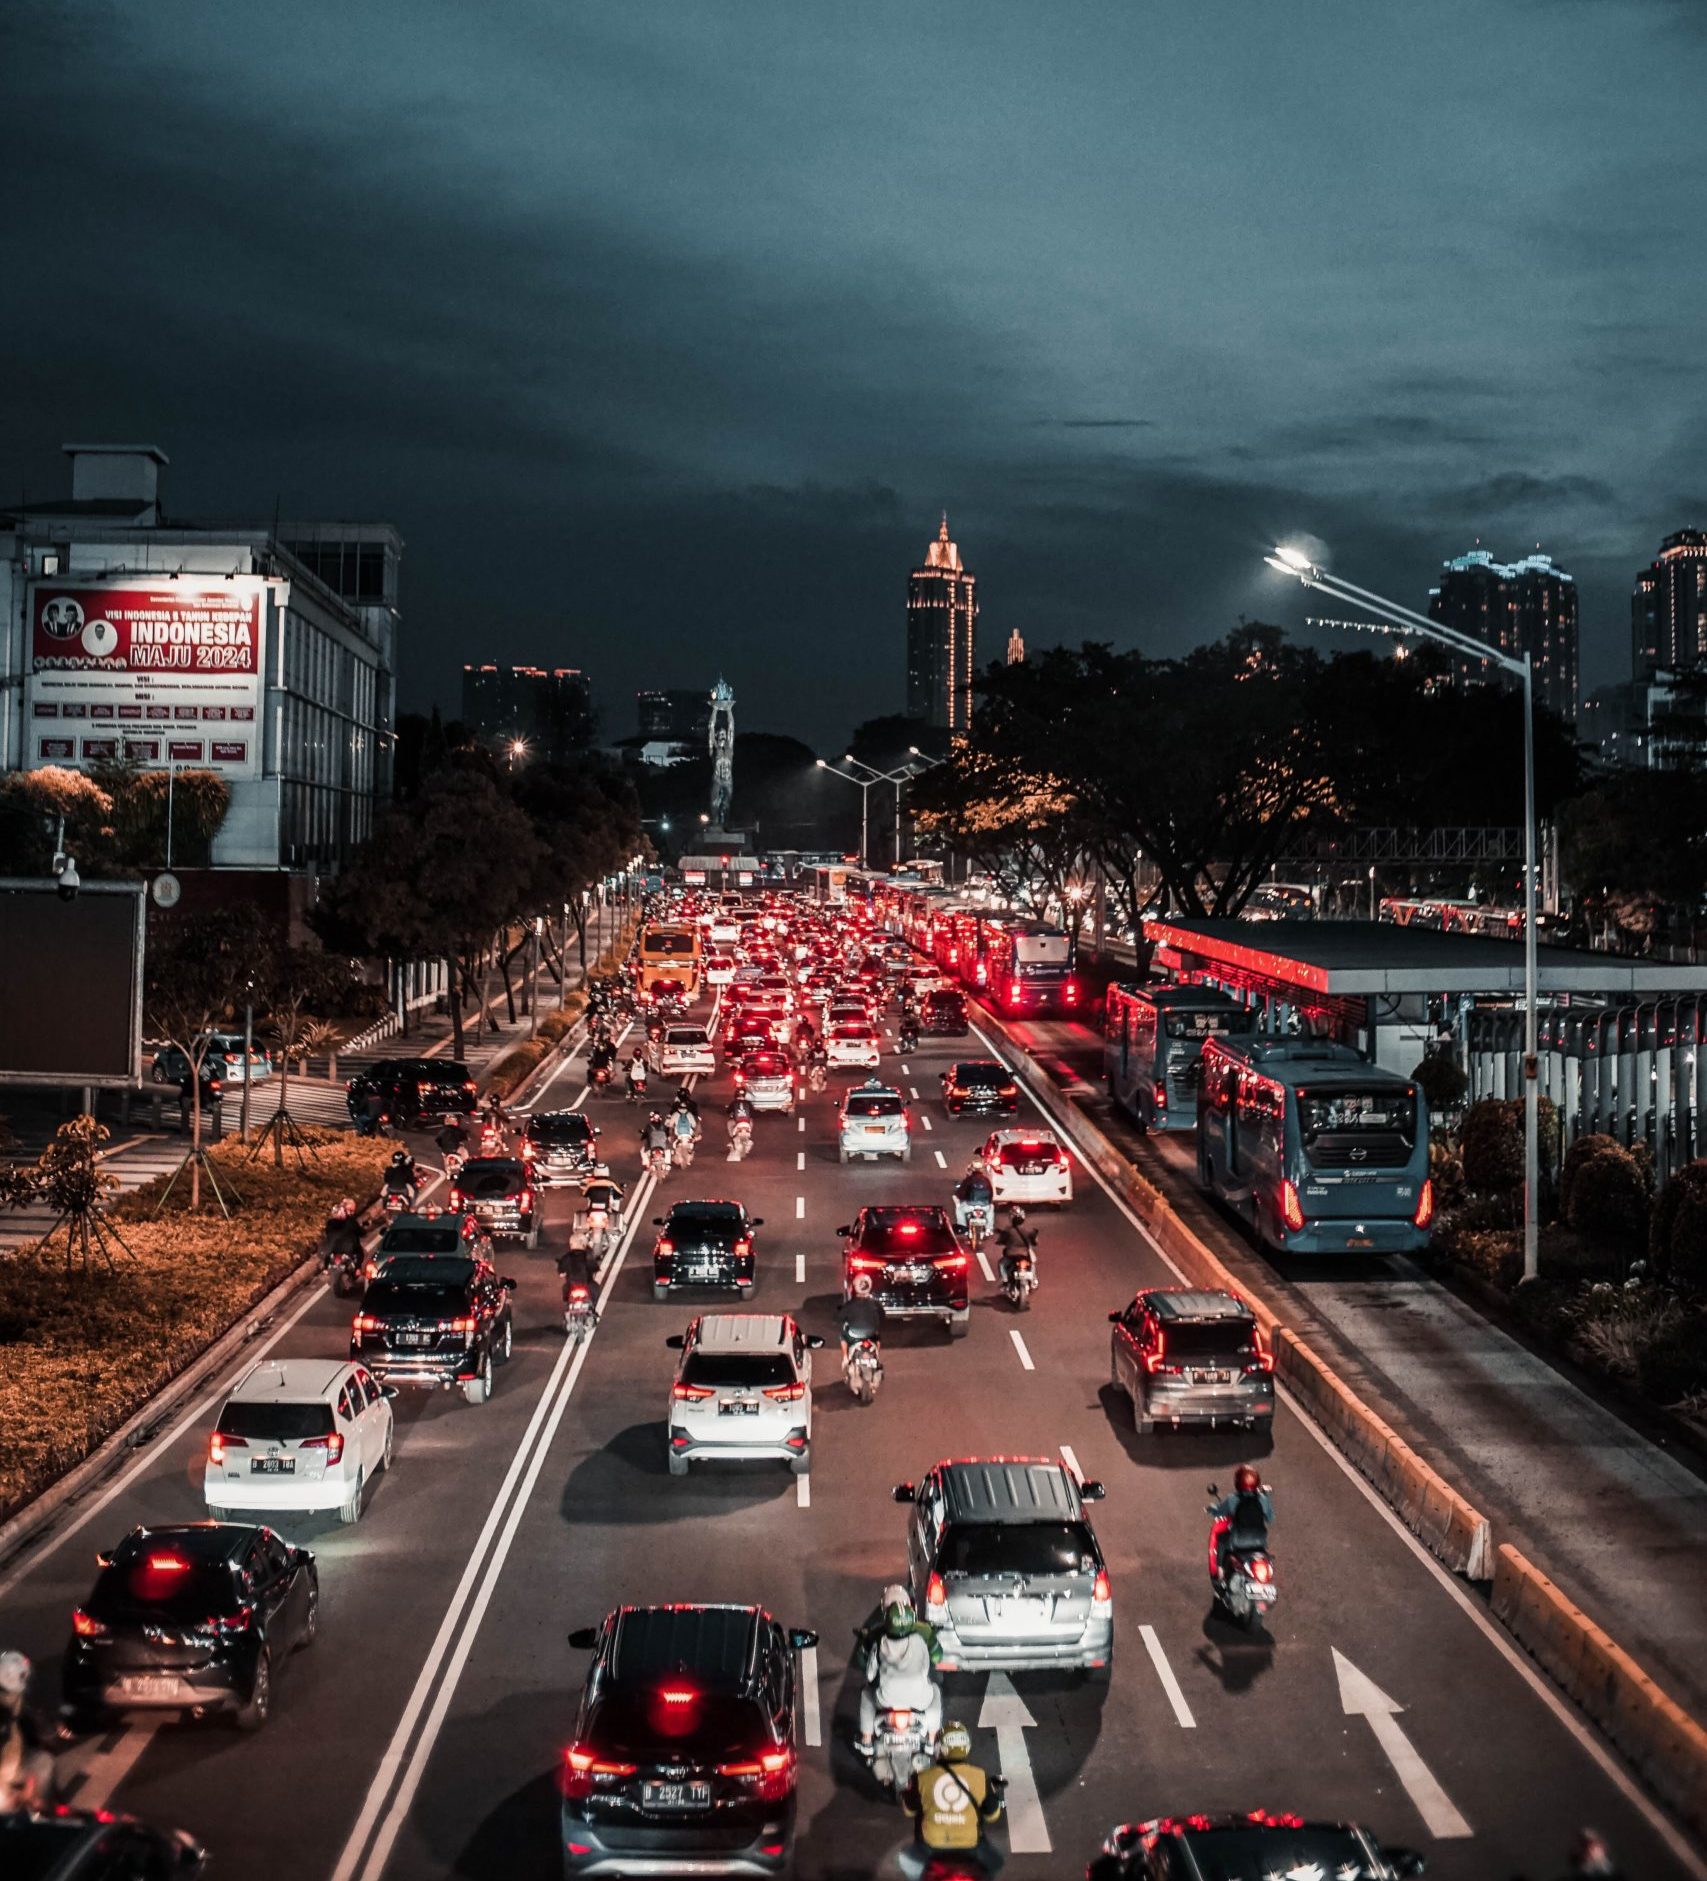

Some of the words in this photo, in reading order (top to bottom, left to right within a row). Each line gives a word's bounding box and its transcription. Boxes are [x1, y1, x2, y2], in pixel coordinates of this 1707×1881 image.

[124, 610, 170, 621] INDONESIA
[130, 621, 252, 645] INDONESIA
[130, 645, 191, 668] MAJU
[196, 646, 251, 669] 2024
